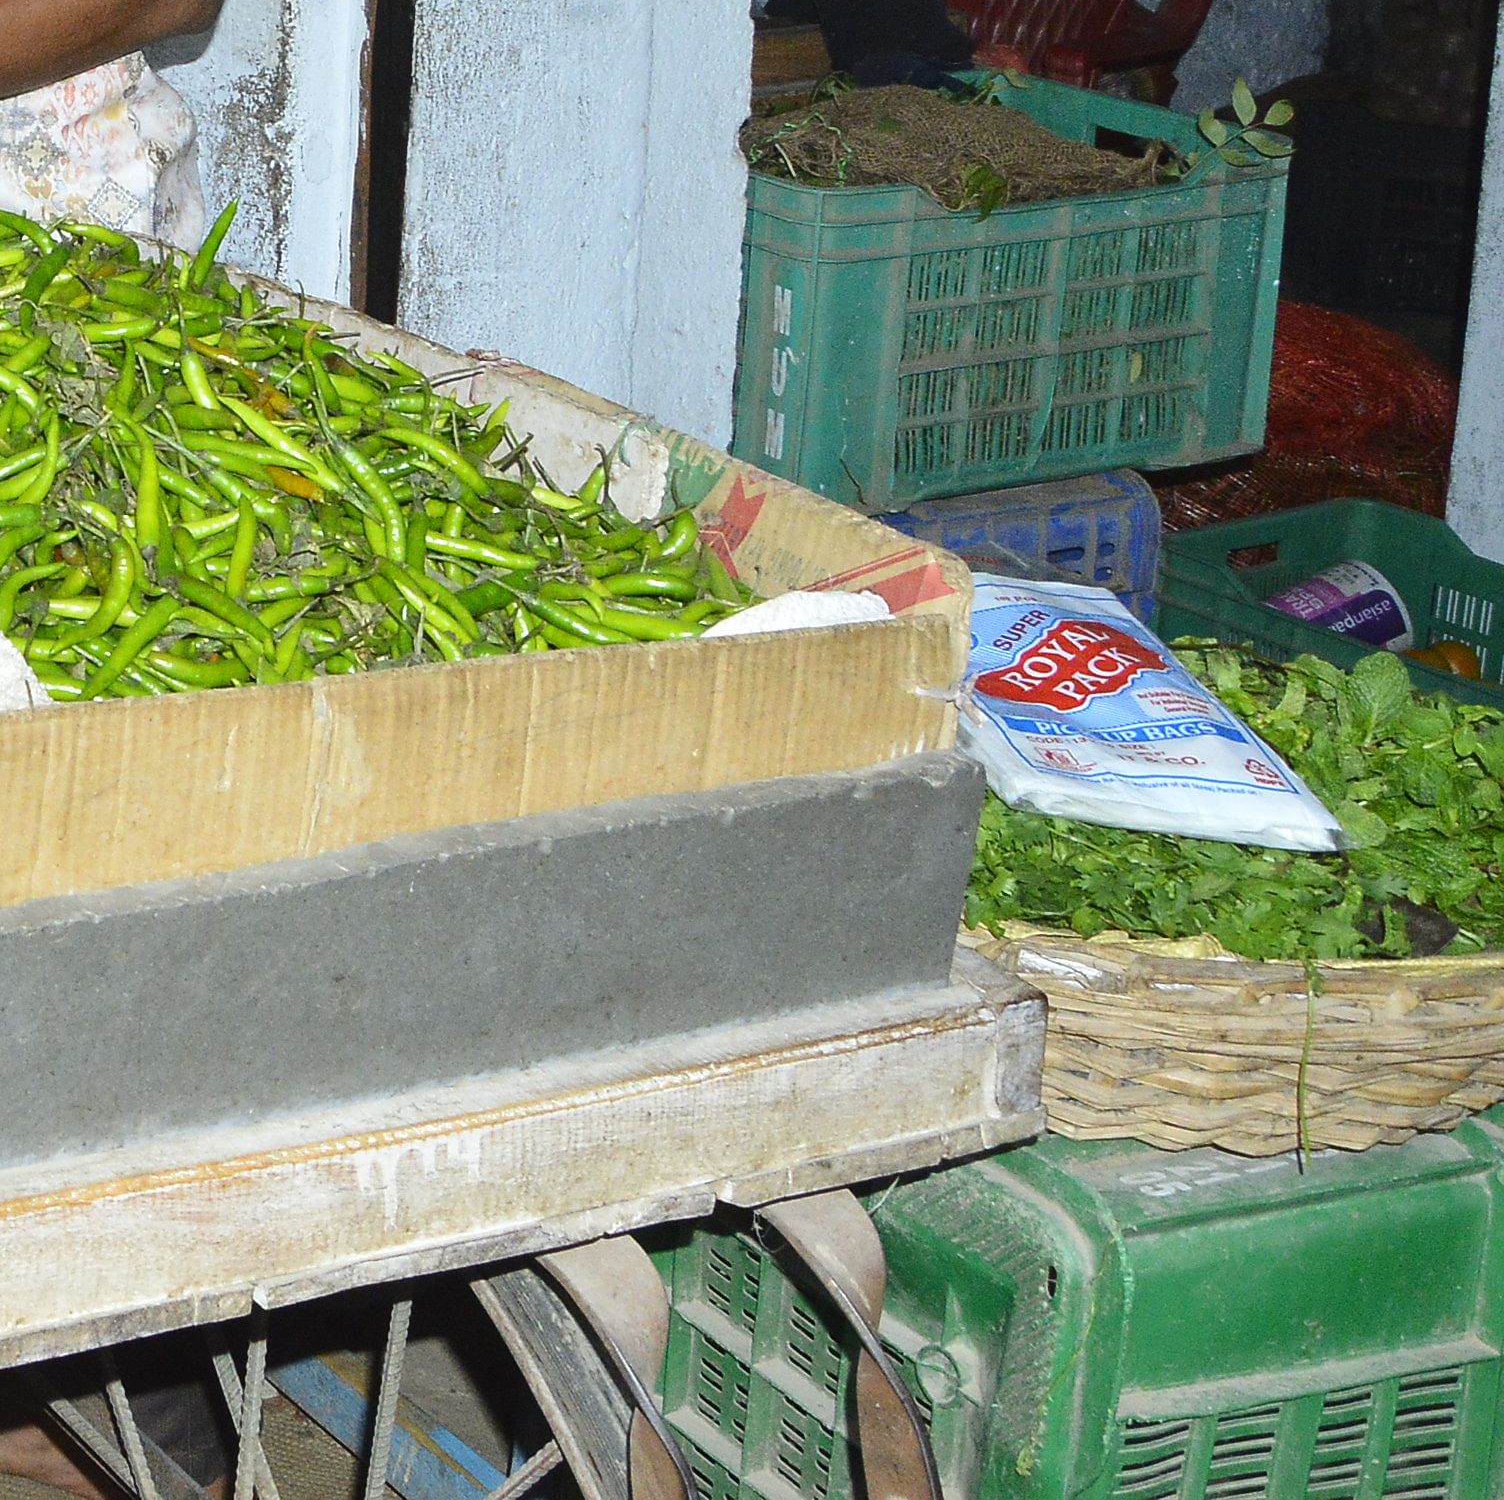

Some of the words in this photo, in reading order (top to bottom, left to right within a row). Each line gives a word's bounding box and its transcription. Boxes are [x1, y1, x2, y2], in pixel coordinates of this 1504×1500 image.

[993, 609, 1050, 651] SUPER
[1000, 624, 1111, 691] ROYAL
[1054, 647, 1141, 701] PACK
[1038, 720, 1078, 737] PIC
[1103, 729, 1135, 743] UP
[1146, 721, 1218, 741] BAGS
